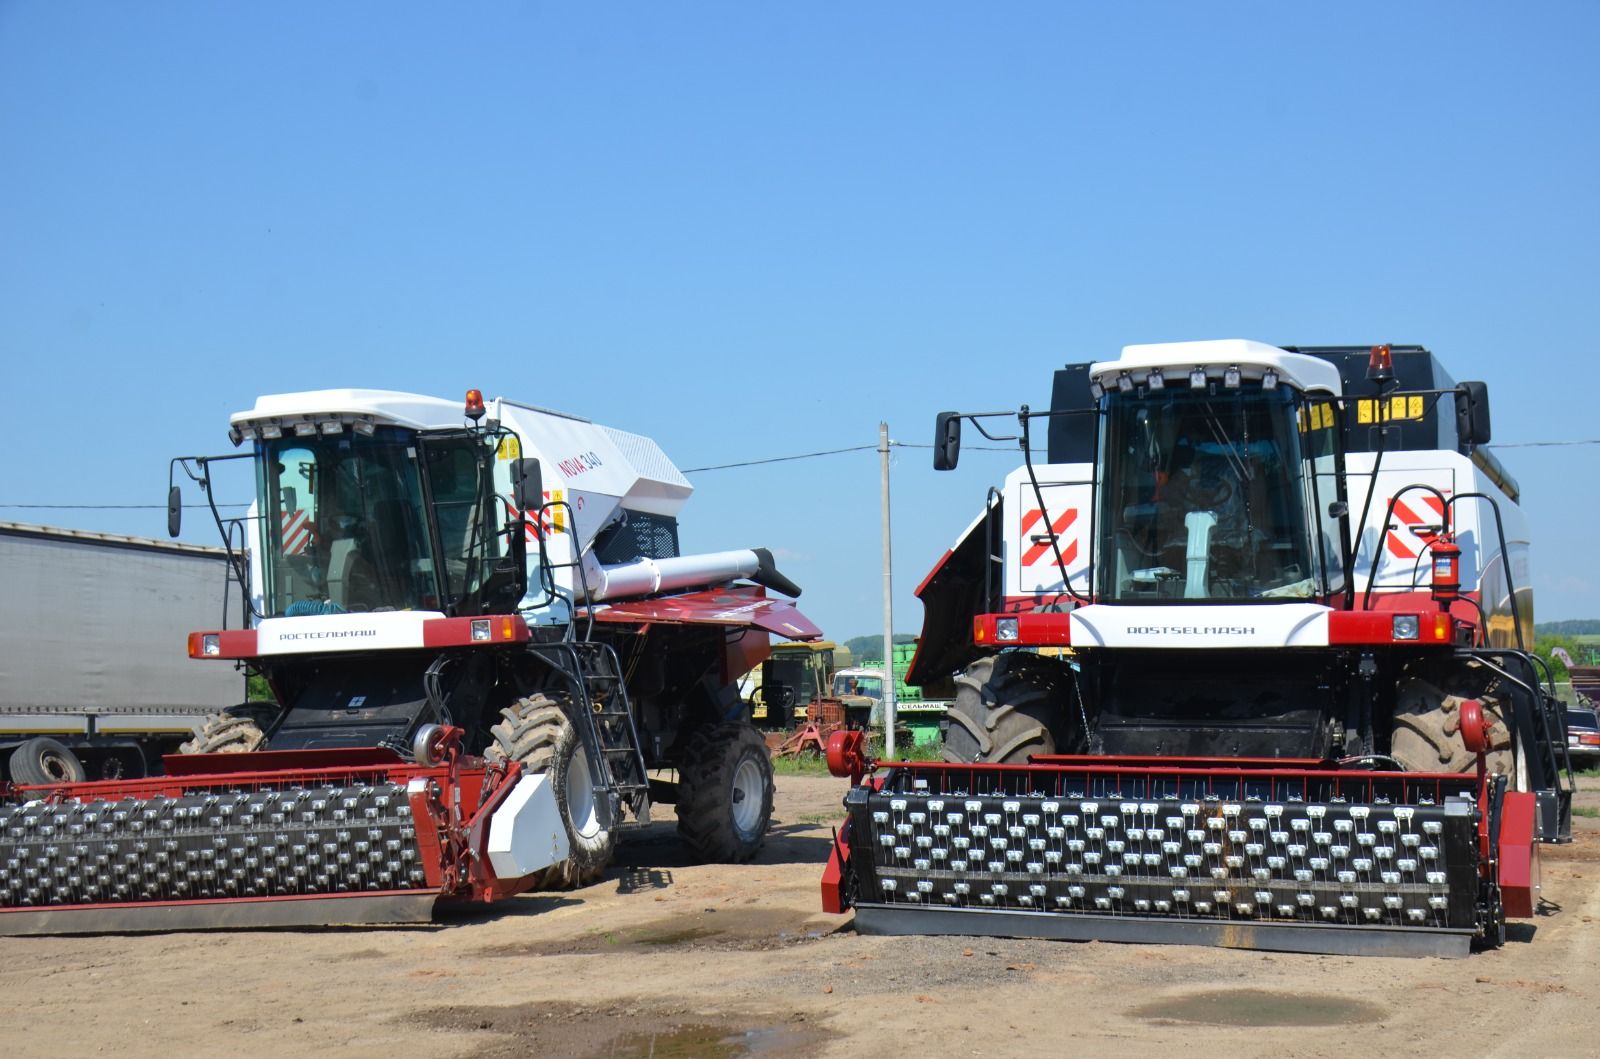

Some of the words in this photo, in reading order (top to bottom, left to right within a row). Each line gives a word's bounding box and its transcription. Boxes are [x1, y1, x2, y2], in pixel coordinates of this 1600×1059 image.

[558, 457, 587, 478] NOVA
[580, 451, 602, 469] 340
[279, 629, 377, 641] РОСТСЕЛЬМАШ
[1126, 626, 1256, 635] ROSTSELMASH
